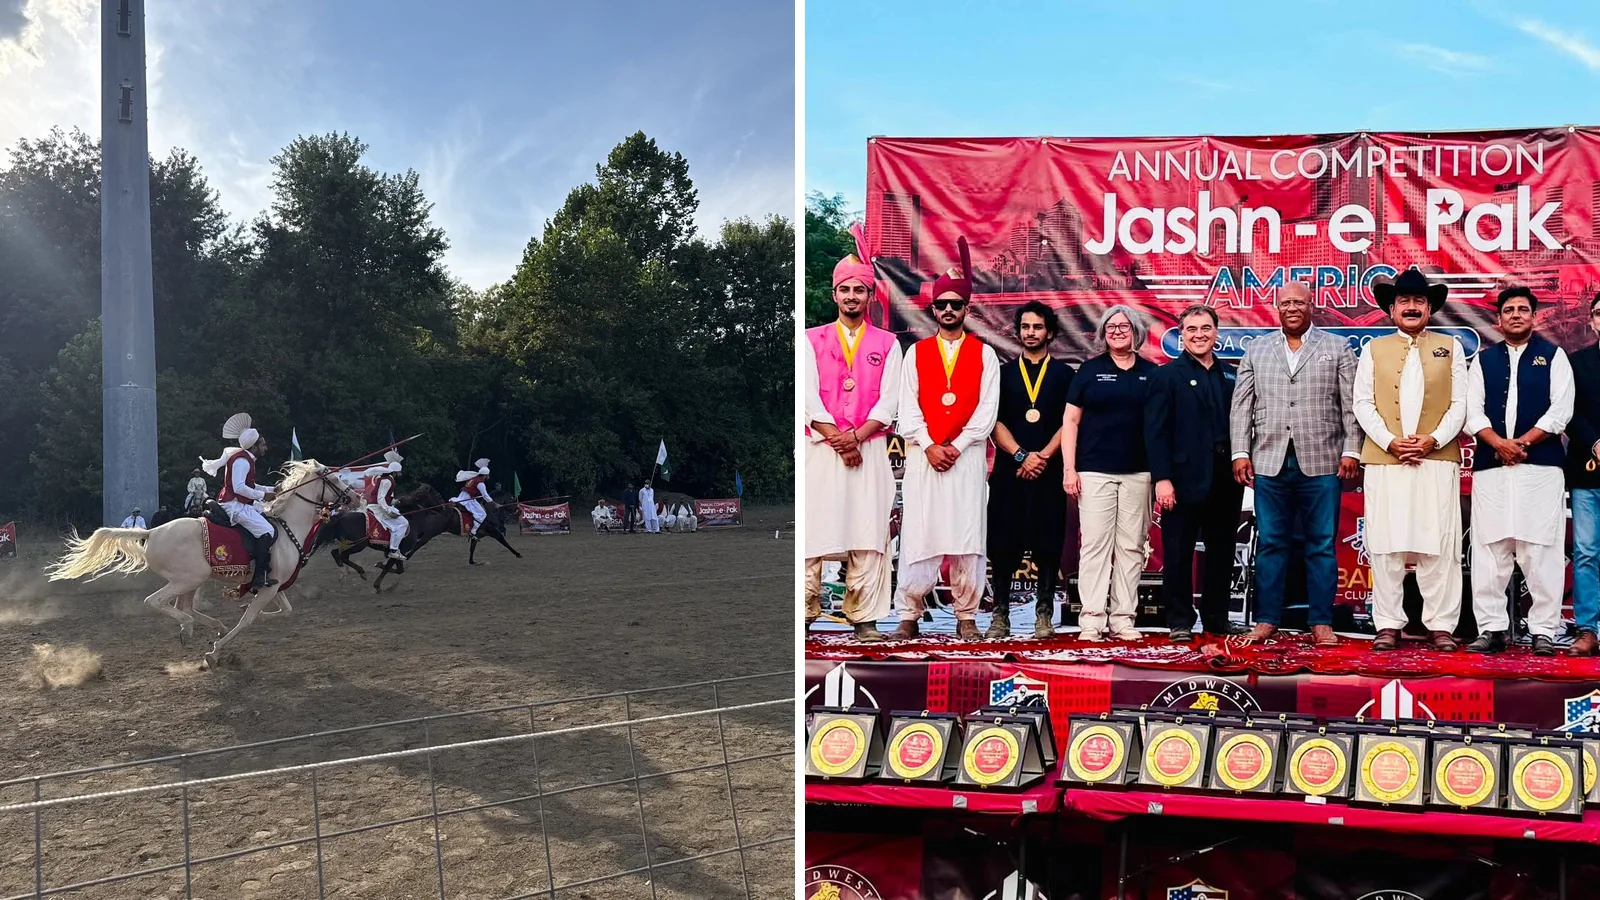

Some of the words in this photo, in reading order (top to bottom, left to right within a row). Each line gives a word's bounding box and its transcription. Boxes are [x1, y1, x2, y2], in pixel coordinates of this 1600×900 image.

[1107, 150, 1263, 182] ANNUAL
[1269, 142, 1545, 180] COMPETITION
[1204, 264, 1423, 309] AMRIC
[1163, 680, 1252, 709] MIDWEST
[811, 869, 874, 898] DWEST
